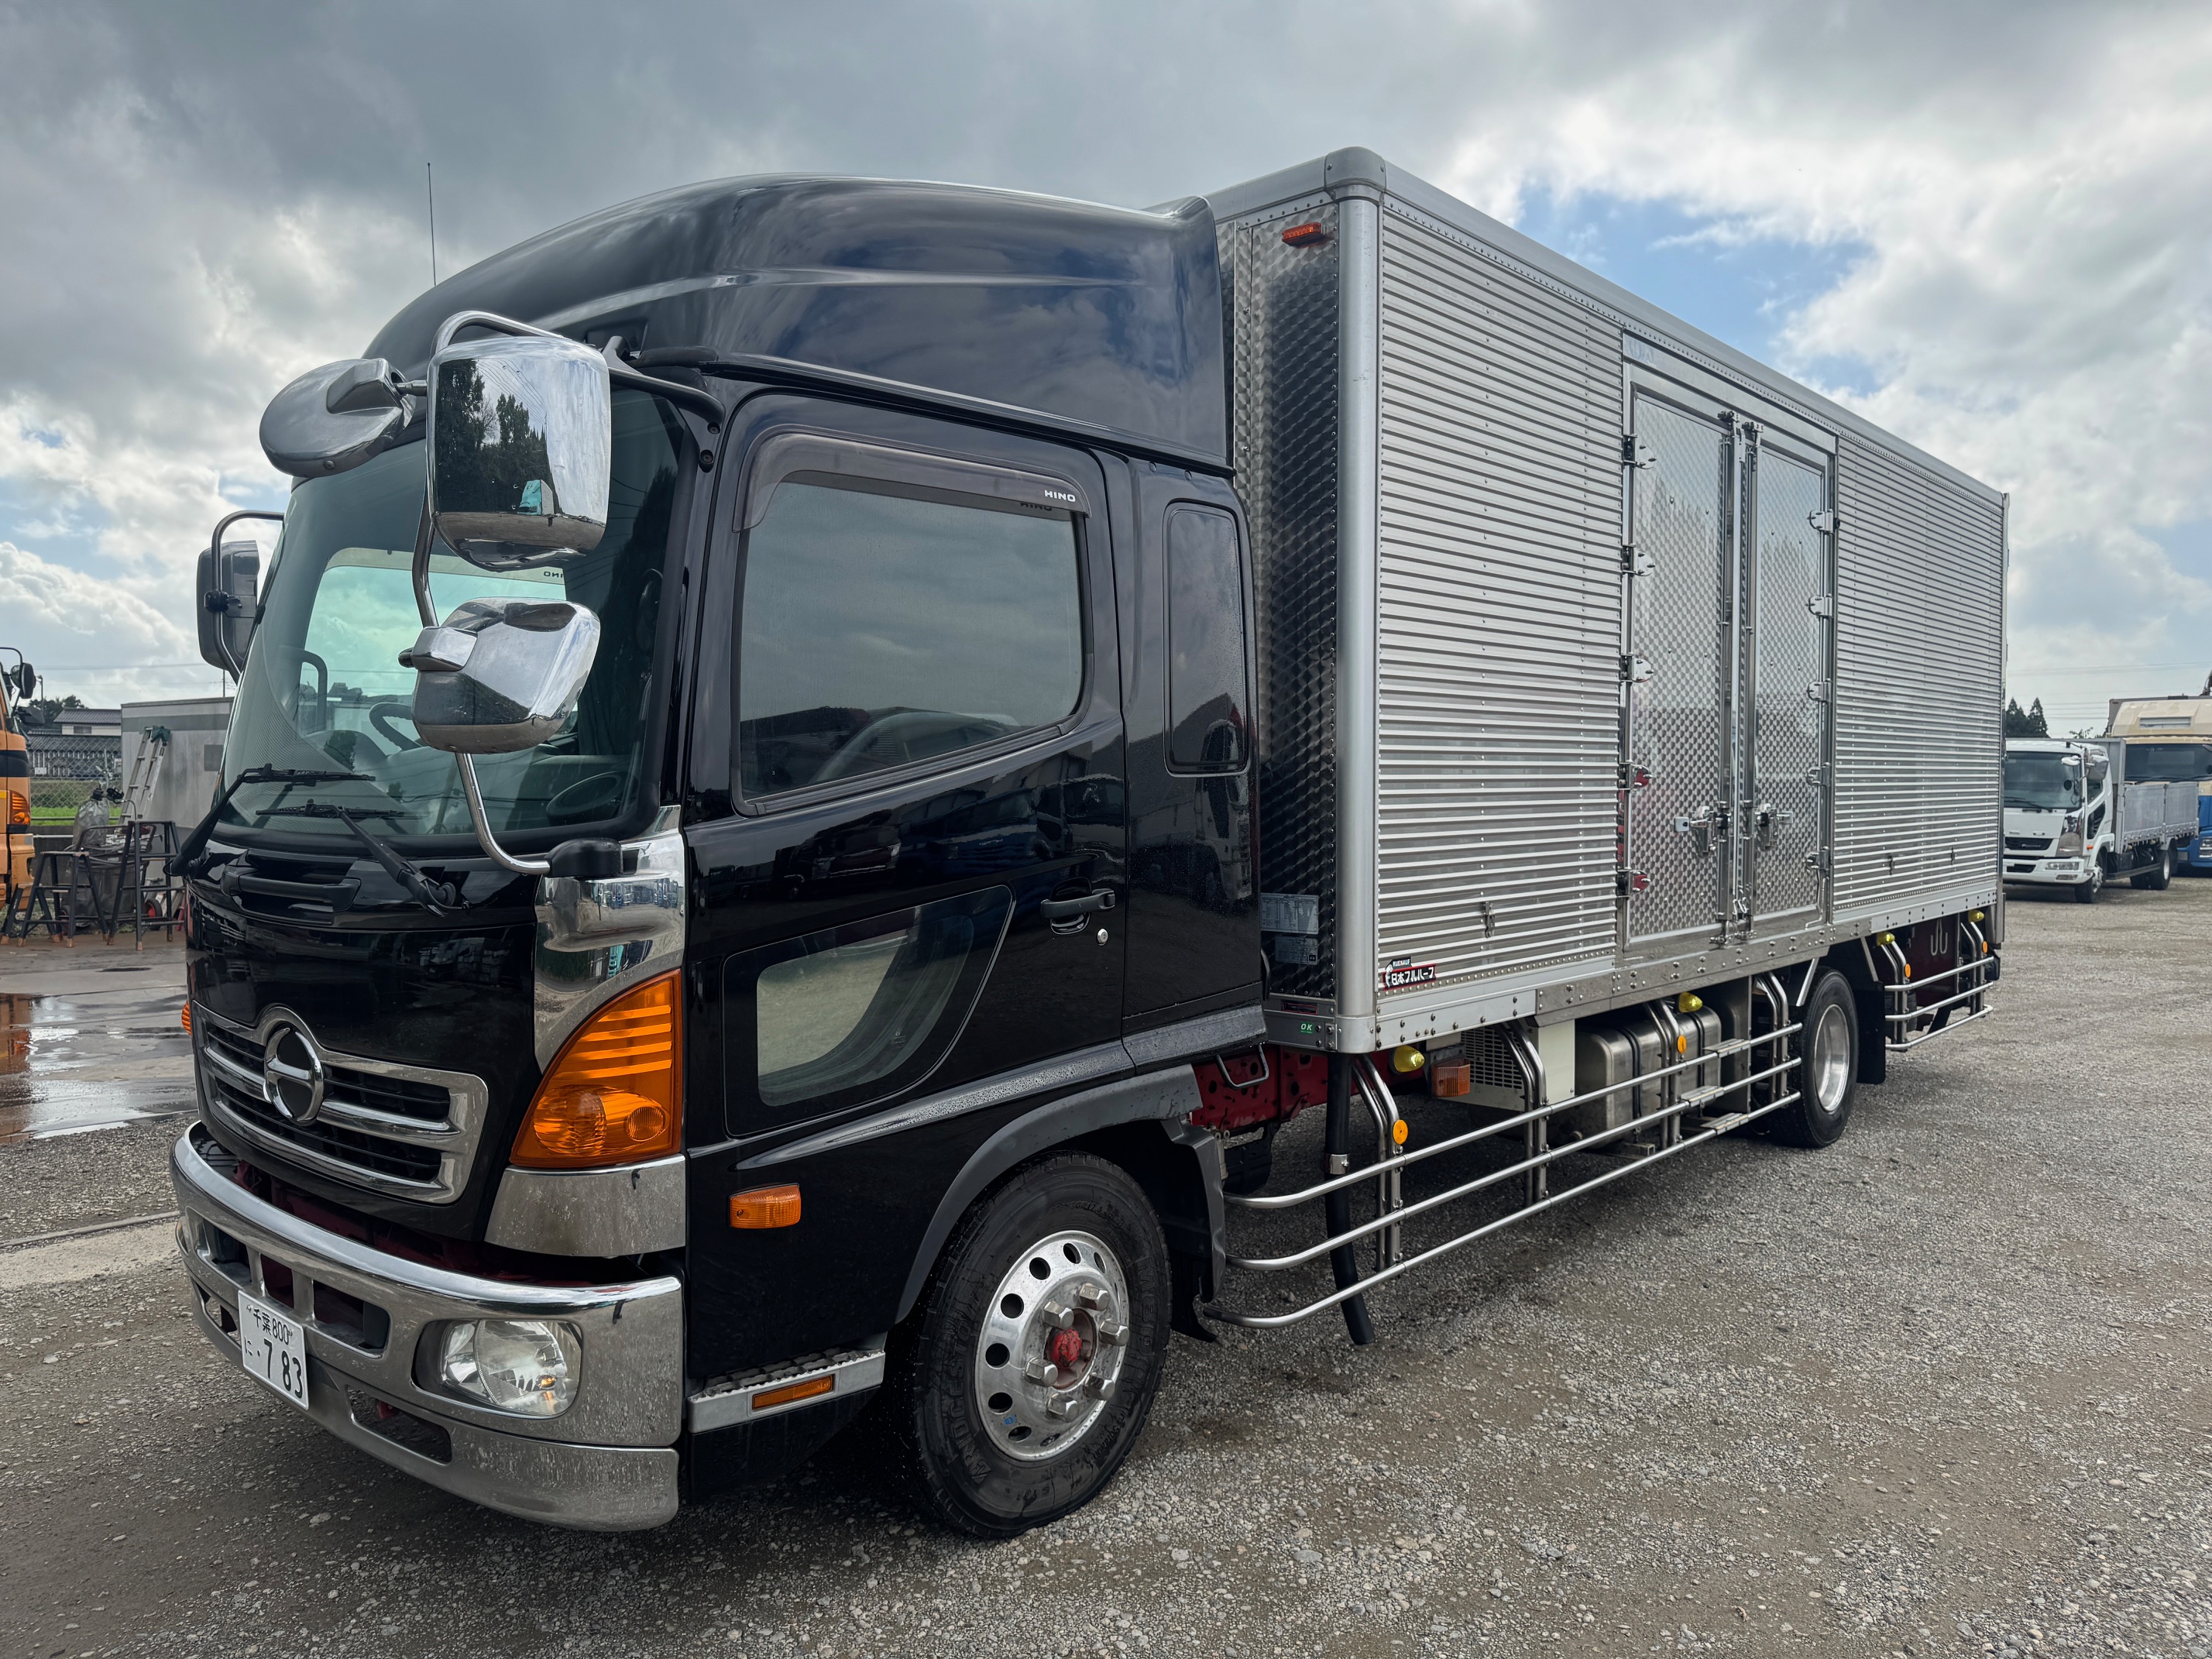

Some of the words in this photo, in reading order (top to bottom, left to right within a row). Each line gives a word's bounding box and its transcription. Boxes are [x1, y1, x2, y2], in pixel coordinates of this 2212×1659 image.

[1044, 490, 1076, 502] HINO
[1391, 967, 1434, 986] 日本フルハーフ
[244, 1336, 253, 1356] に
